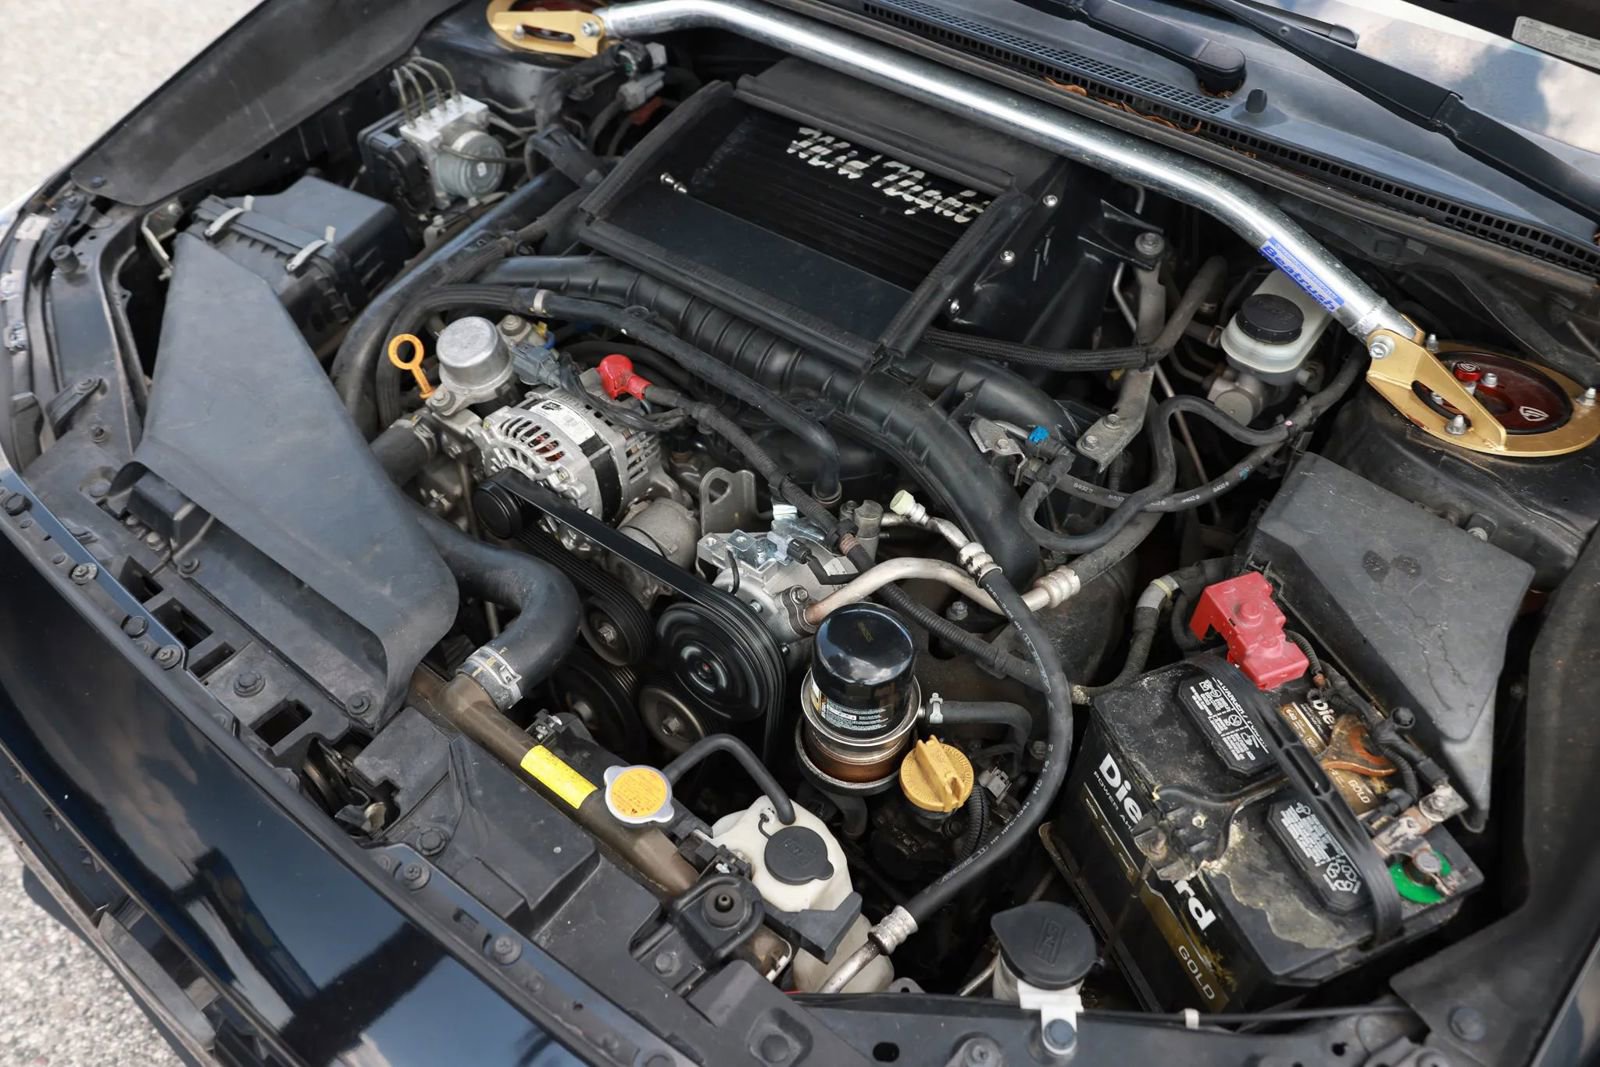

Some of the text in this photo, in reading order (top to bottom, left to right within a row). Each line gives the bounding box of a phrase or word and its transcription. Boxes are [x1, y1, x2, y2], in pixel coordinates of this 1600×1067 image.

[1263, 245, 1335, 310] Beatrush
[1312, 699, 1336, 730] Die
[1093, 770, 1120, 811] POWER
[1347, 778, 1372, 804] GOLD
[1177, 944, 1216, 1001] GOLD
